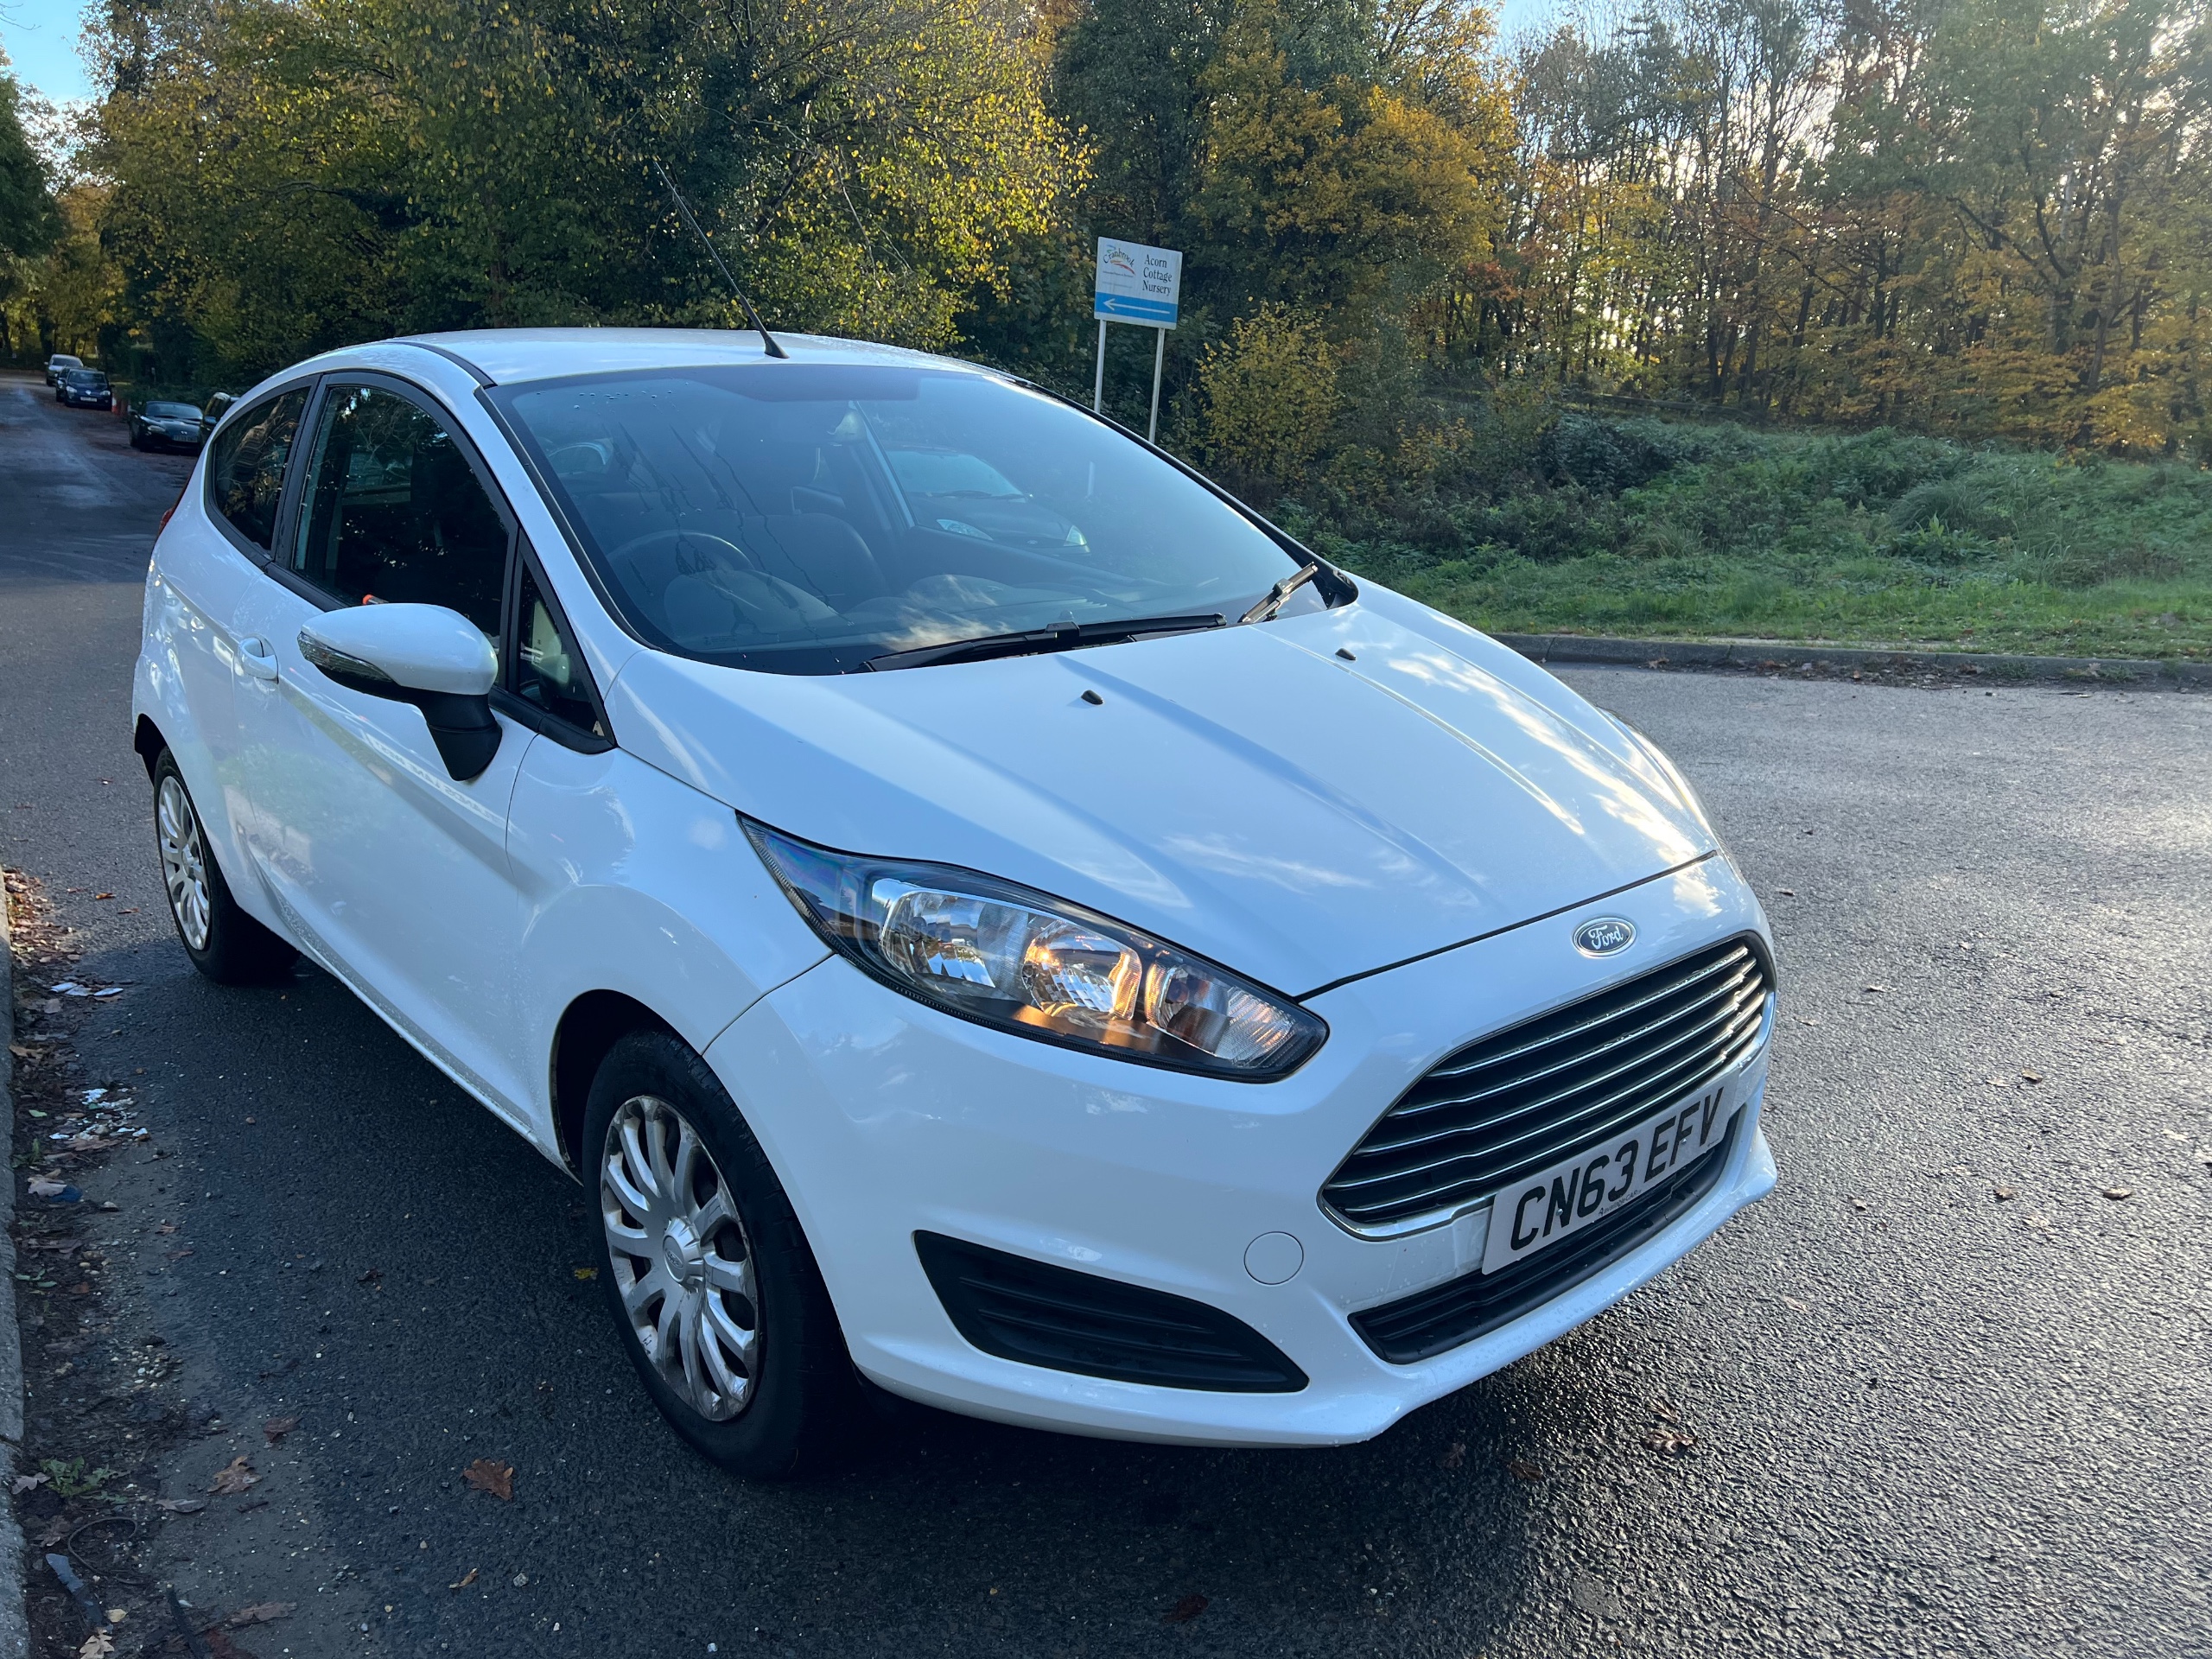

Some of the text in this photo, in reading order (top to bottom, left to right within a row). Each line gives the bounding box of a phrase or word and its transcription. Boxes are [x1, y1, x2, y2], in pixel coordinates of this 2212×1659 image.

[1144, 253, 1167, 269] Acorn
[1143, 266, 1173, 283] Cottage
[1142, 279, 1172, 296] Nursery
[1588, 925, 1624, 950] Ford
[1510, 1085, 1725, 1251] CN63 EFV
